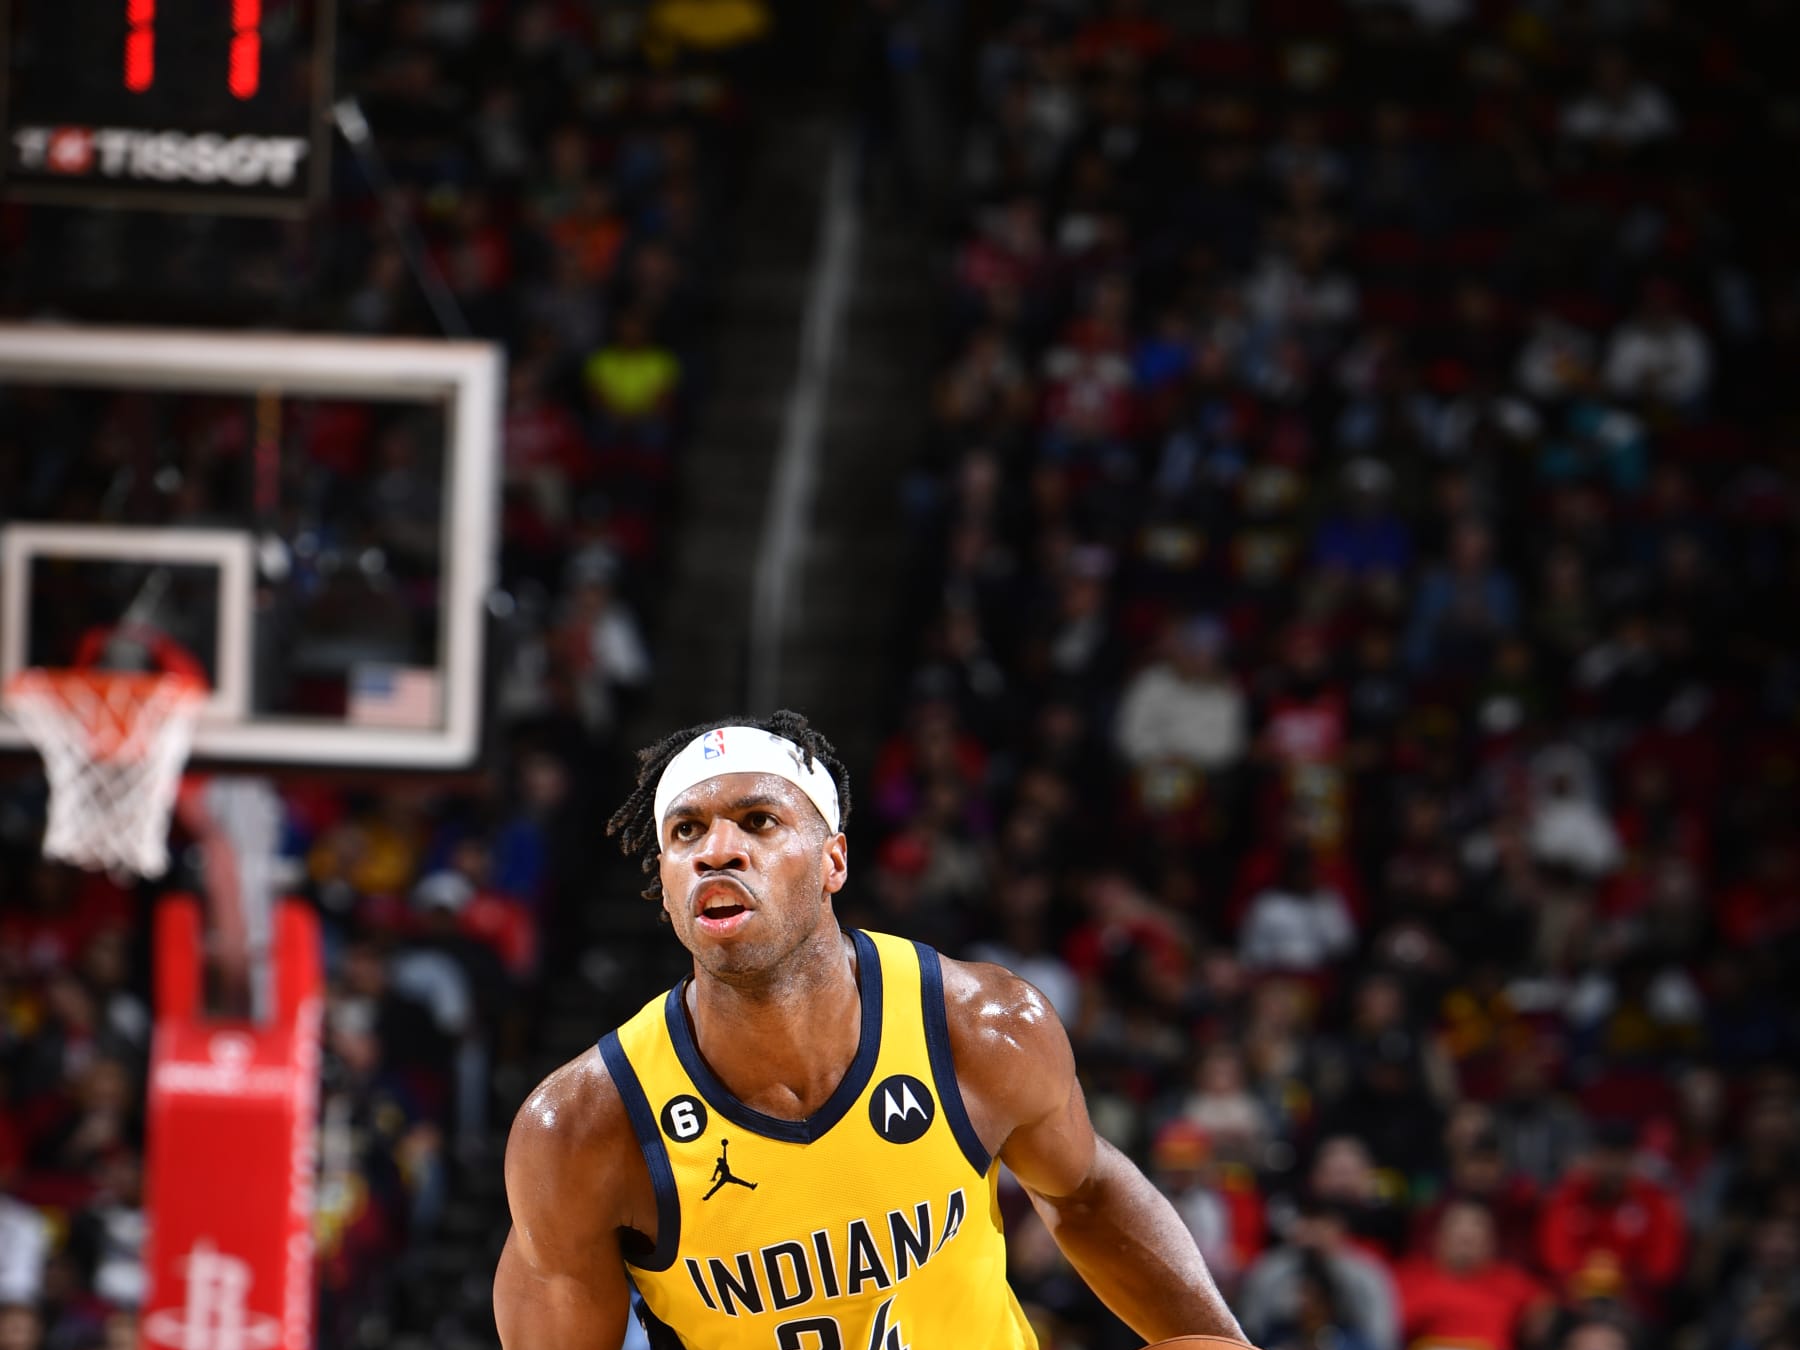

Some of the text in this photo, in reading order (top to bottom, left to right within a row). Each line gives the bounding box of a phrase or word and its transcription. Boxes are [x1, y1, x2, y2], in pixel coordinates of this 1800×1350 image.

[95, 128, 308, 186] TISSOT
[670, 1101, 700, 1137] 6
[685, 1188, 967, 1317] INDIANA
